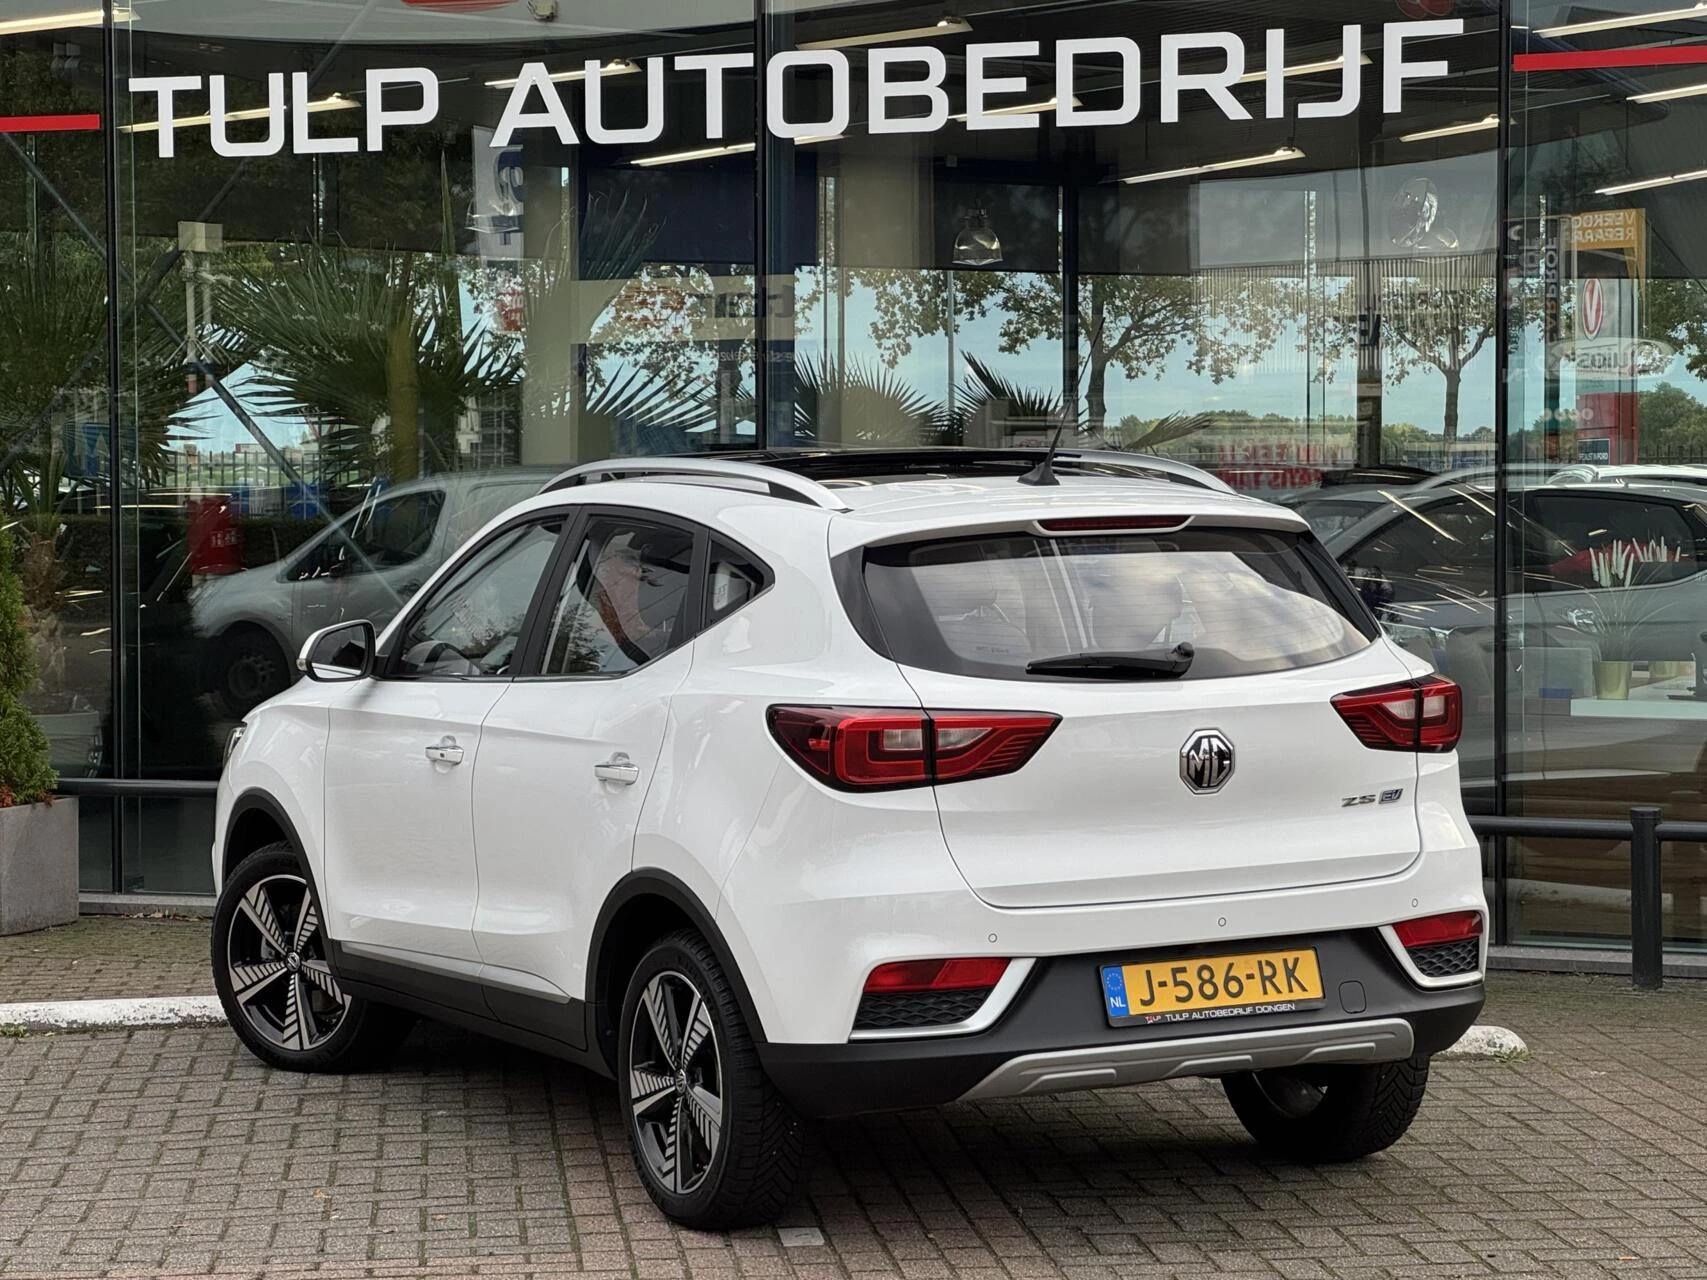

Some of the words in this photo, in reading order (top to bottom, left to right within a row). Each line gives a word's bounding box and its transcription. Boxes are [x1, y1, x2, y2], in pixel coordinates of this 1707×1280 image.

[128, 67, 439, 159] TULP
[489, 18, 1464, 148] AUTOBEDRIJF
[1188, 737, 1230, 786] MG
[1341, 794, 1376, 807] ZS
[1383, 789, 1403, 801] EV
[1139, 956, 1308, 1006] J-586-RK
[1110, 996, 1126, 1008] NL
[1165, 1012, 1189, 1021] TULP
[1191, 1006, 1253, 1019] AUTOBEDRIJF
[1255, 1002, 1295, 1014] DONGEN
